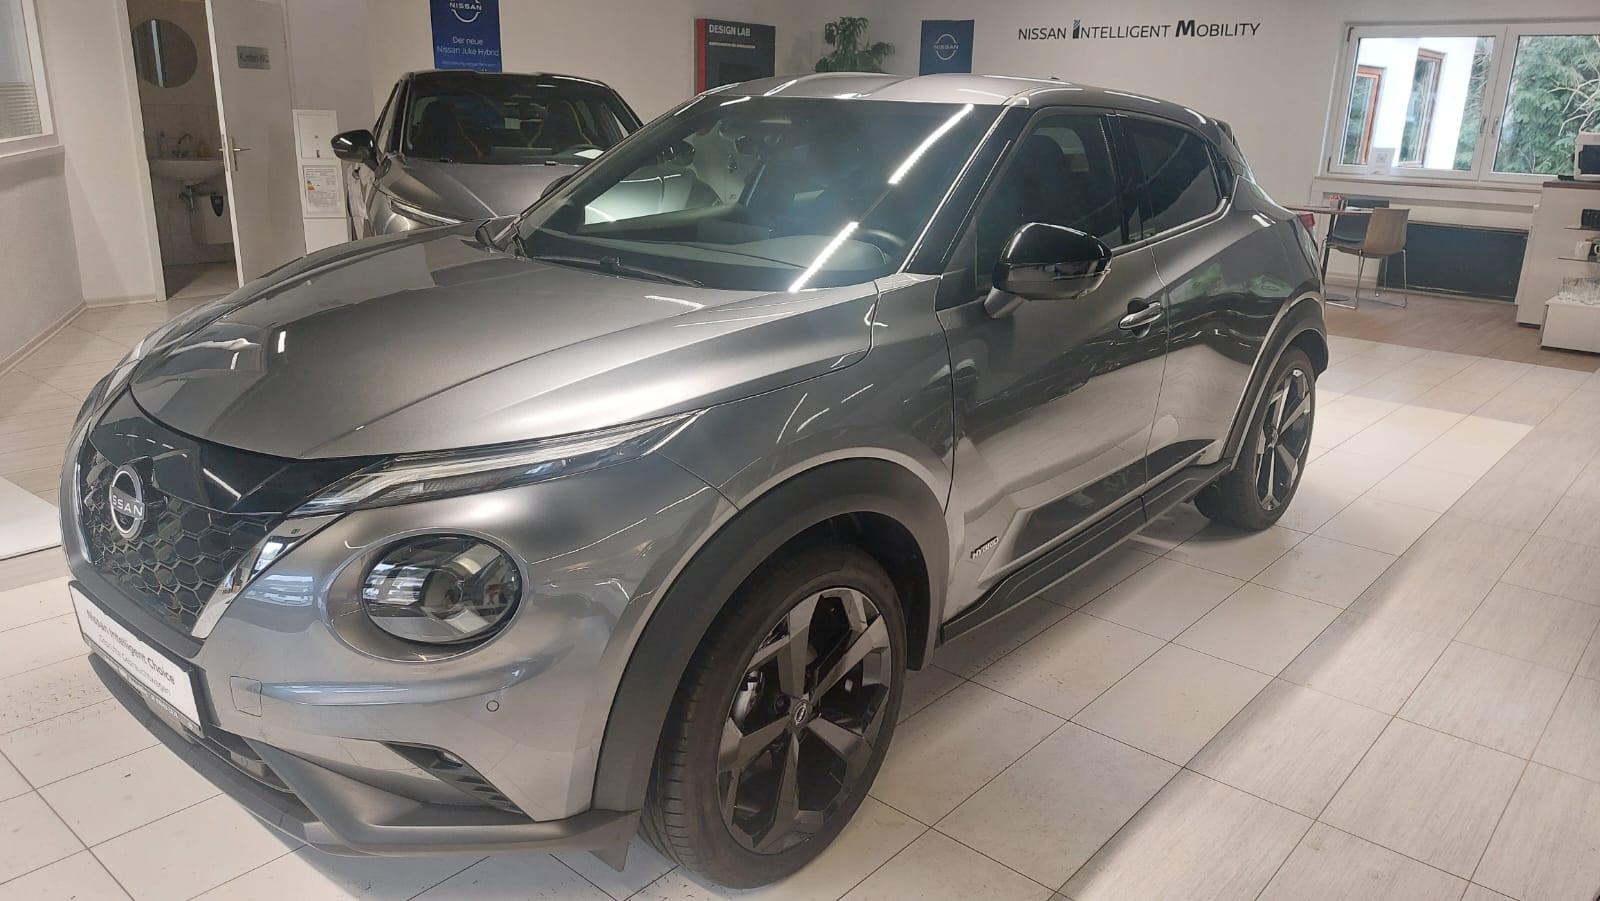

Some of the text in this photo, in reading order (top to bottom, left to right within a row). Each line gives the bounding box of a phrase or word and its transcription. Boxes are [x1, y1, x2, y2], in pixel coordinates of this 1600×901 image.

[449, 2, 482, 11] NISSAN
[708, 24, 751, 37] DESIGN LAB
[1018, 17, 1261, 40] NISSAN INTELLIGENT MOBILITY
[452, 36, 484, 46] Der neue
[437, 45, 460, 54] Nissan
[108, 626, 148, 664] Intelligent
[147, 658, 176, 685] Choice
